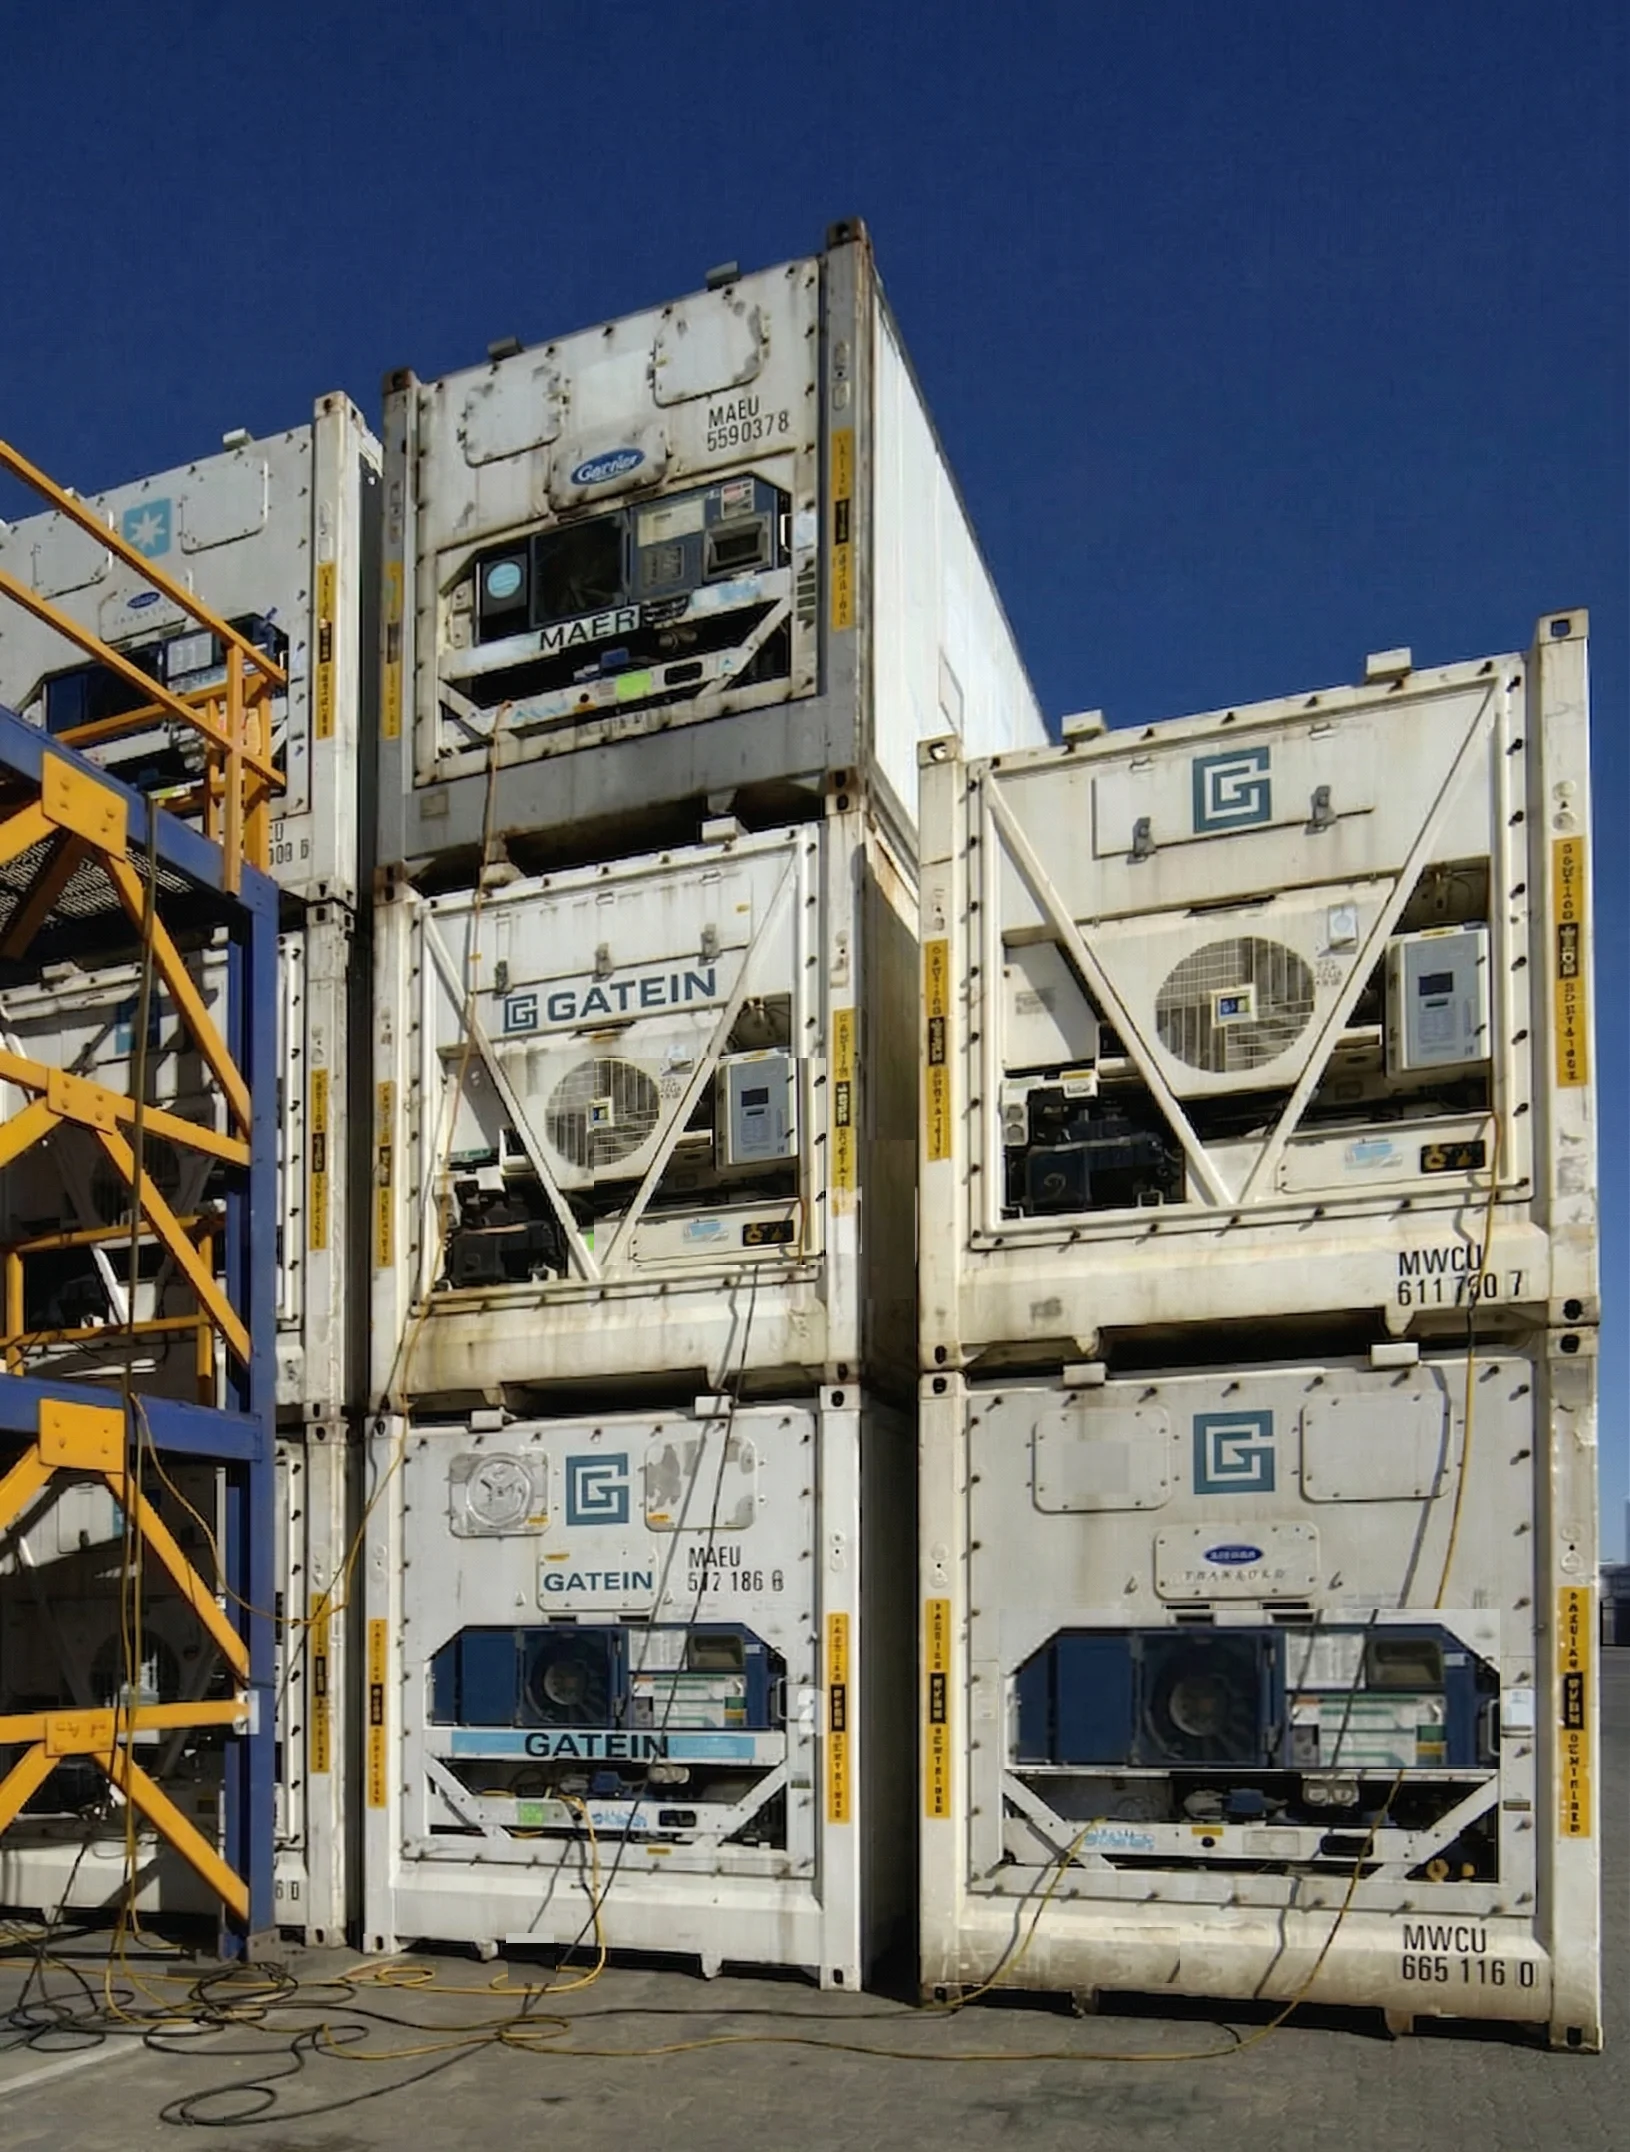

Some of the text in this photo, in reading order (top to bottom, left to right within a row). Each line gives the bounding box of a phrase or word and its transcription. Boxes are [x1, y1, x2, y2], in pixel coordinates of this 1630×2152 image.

[709, 396, 759, 429] MAEU
[547, 967, 716, 1022] GATEIN
[1398, 1244, 1482, 1276] MWCU
[688, 1545, 741, 1569] MAEU
[543, 1571, 653, 1592] GATEIN
[525, 1733, 669, 1758] GATEIN
[1403, 1924, 1486, 1953] MWCU
[1402, 1955, 1448, 1982] 665
[1461, 1958, 1505, 1986] 116
